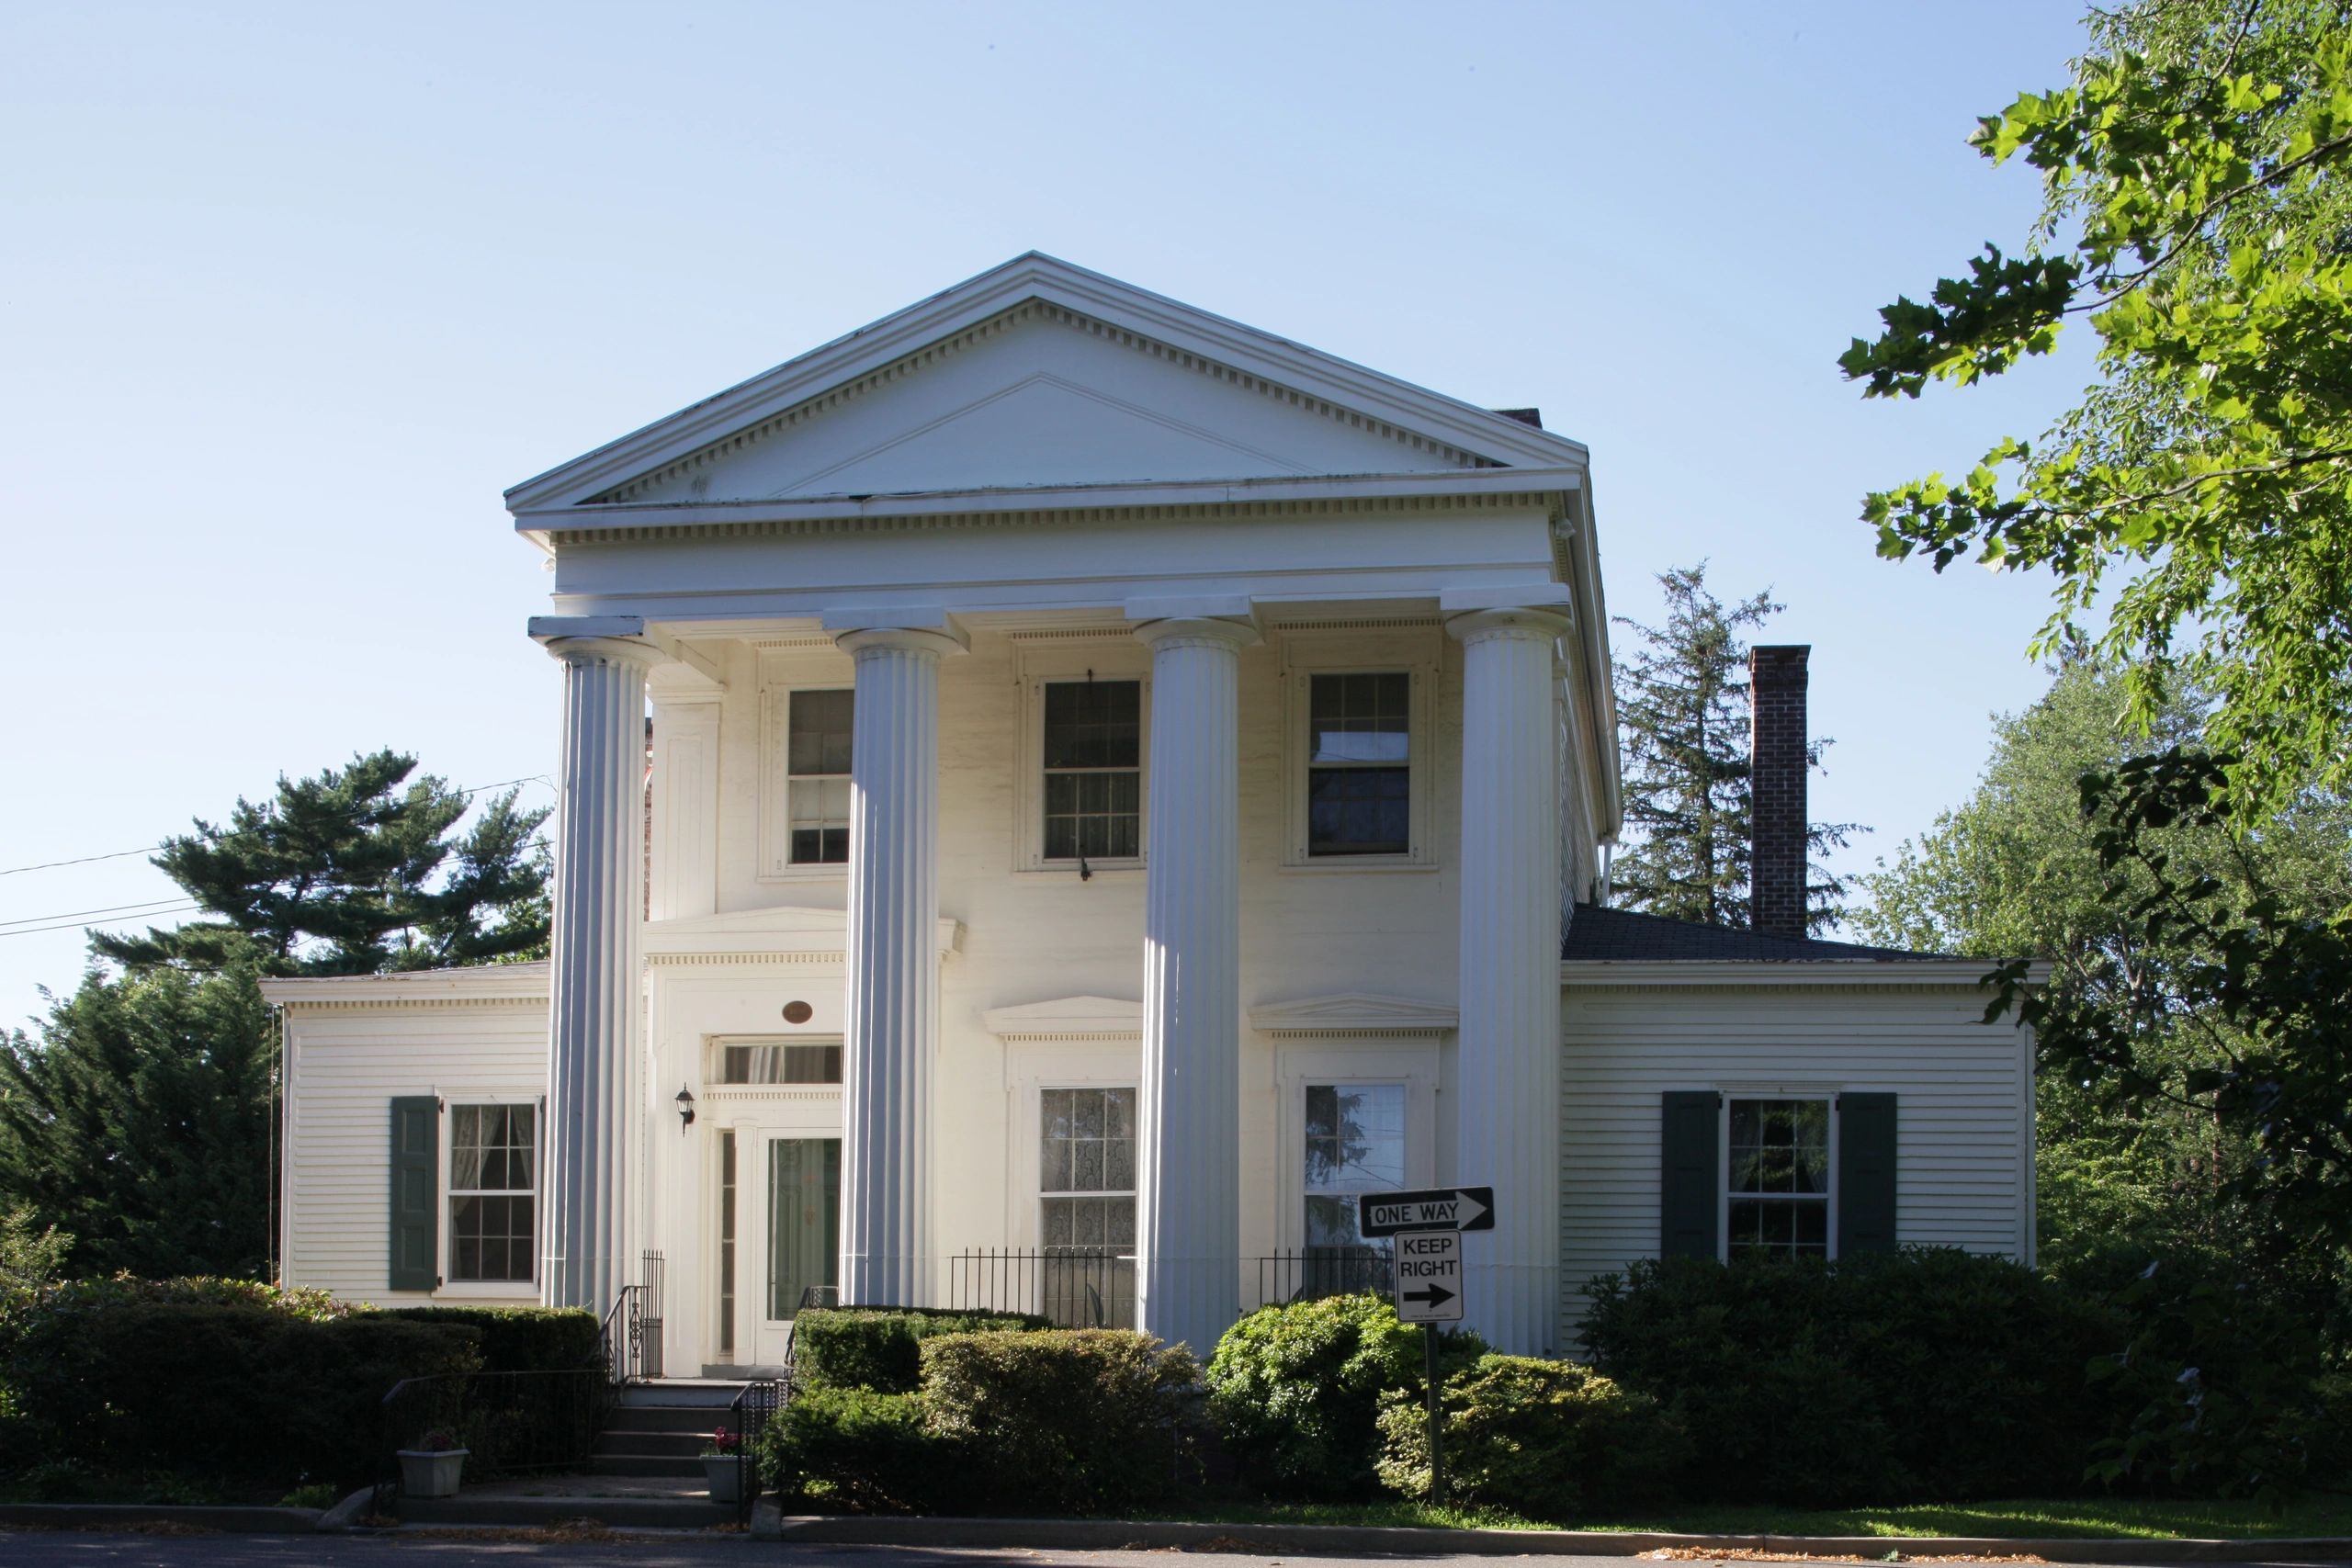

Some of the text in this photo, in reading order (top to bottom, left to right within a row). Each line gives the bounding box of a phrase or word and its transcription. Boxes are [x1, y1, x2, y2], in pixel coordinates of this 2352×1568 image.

[1375, 1202, 1459, 1224] ONE WAY
[1404, 1238, 1452, 1254] KEEP
[1401, 1260, 1457, 1277] RIGHT
